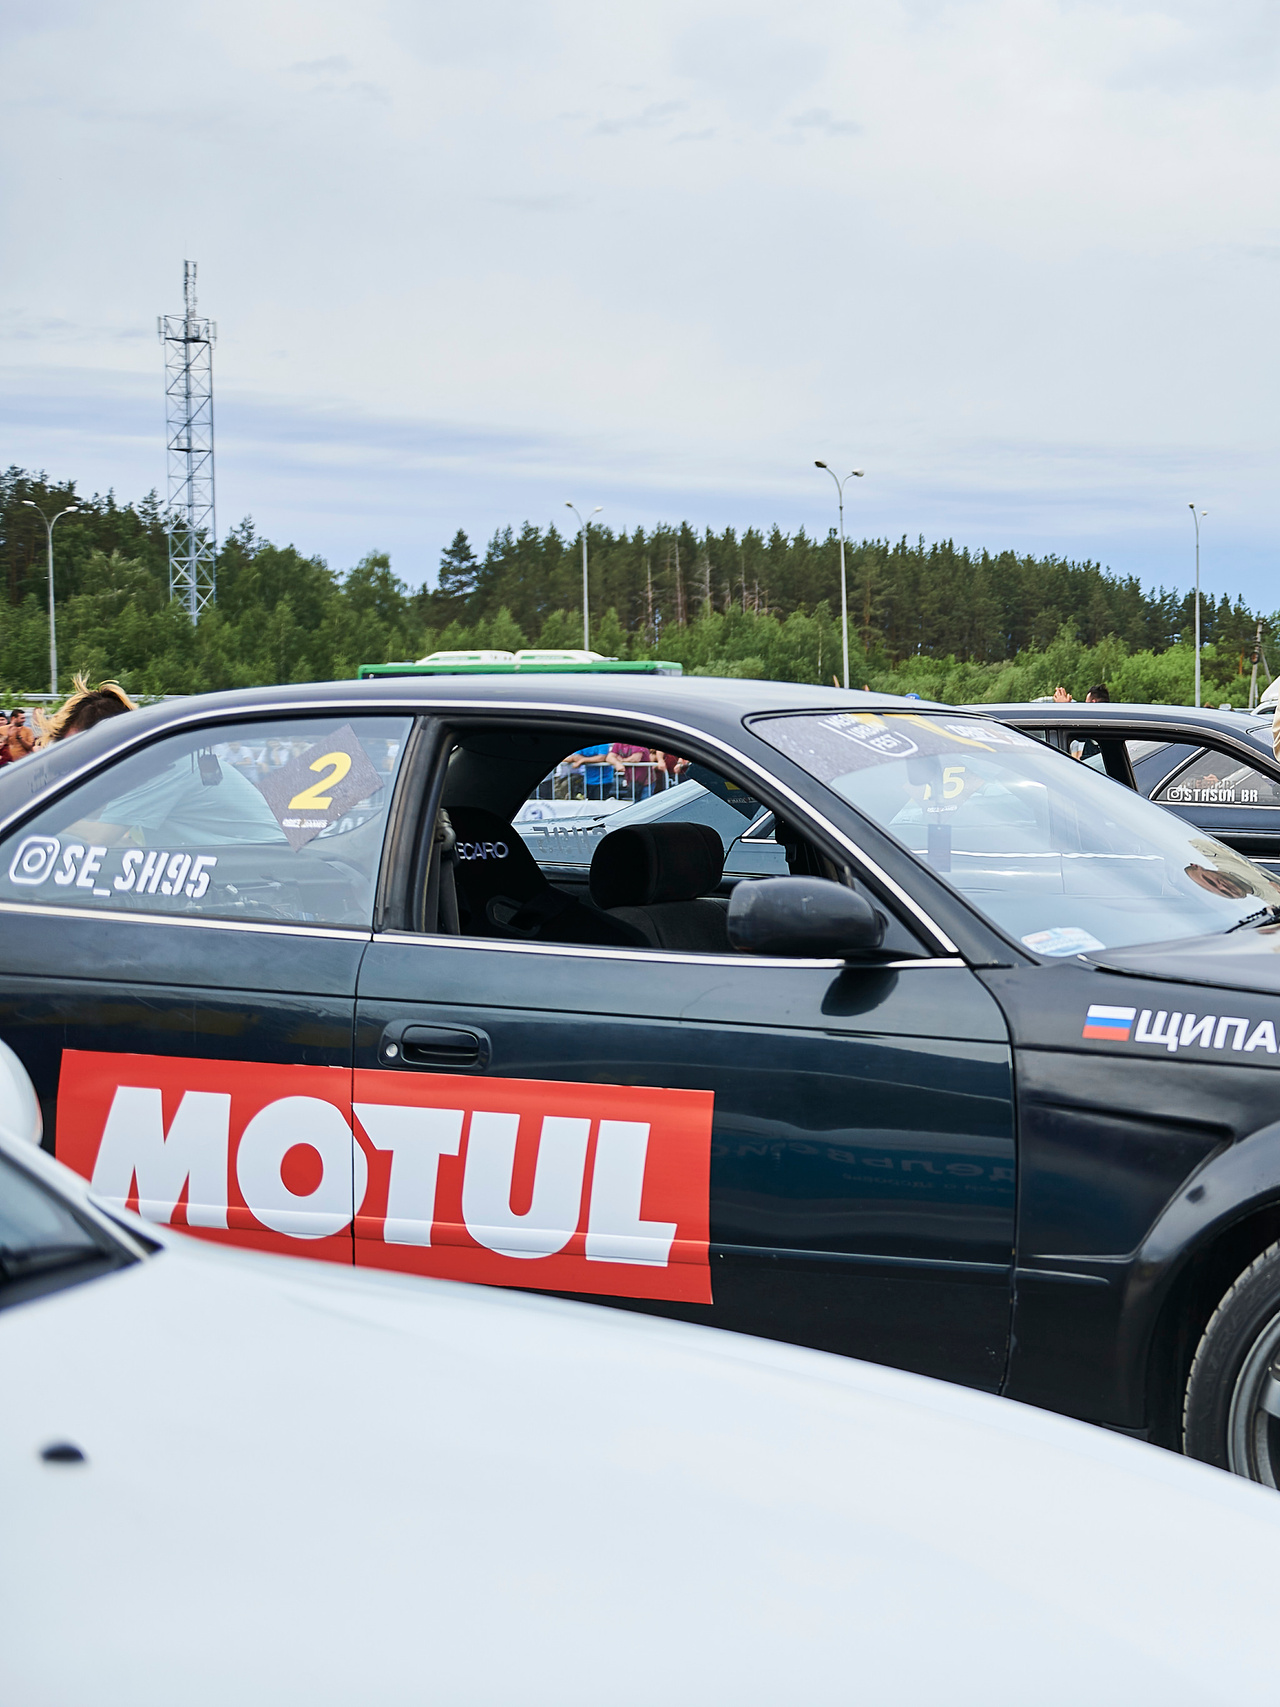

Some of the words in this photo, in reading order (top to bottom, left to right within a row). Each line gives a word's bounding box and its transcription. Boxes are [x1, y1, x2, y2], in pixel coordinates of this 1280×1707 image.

[287, 751, 352, 810] 2
[54, 845, 218, 898] SE_SH95
[456, 841, 509, 861] ECARO
[89, 1084, 679, 1269] MOTUL
